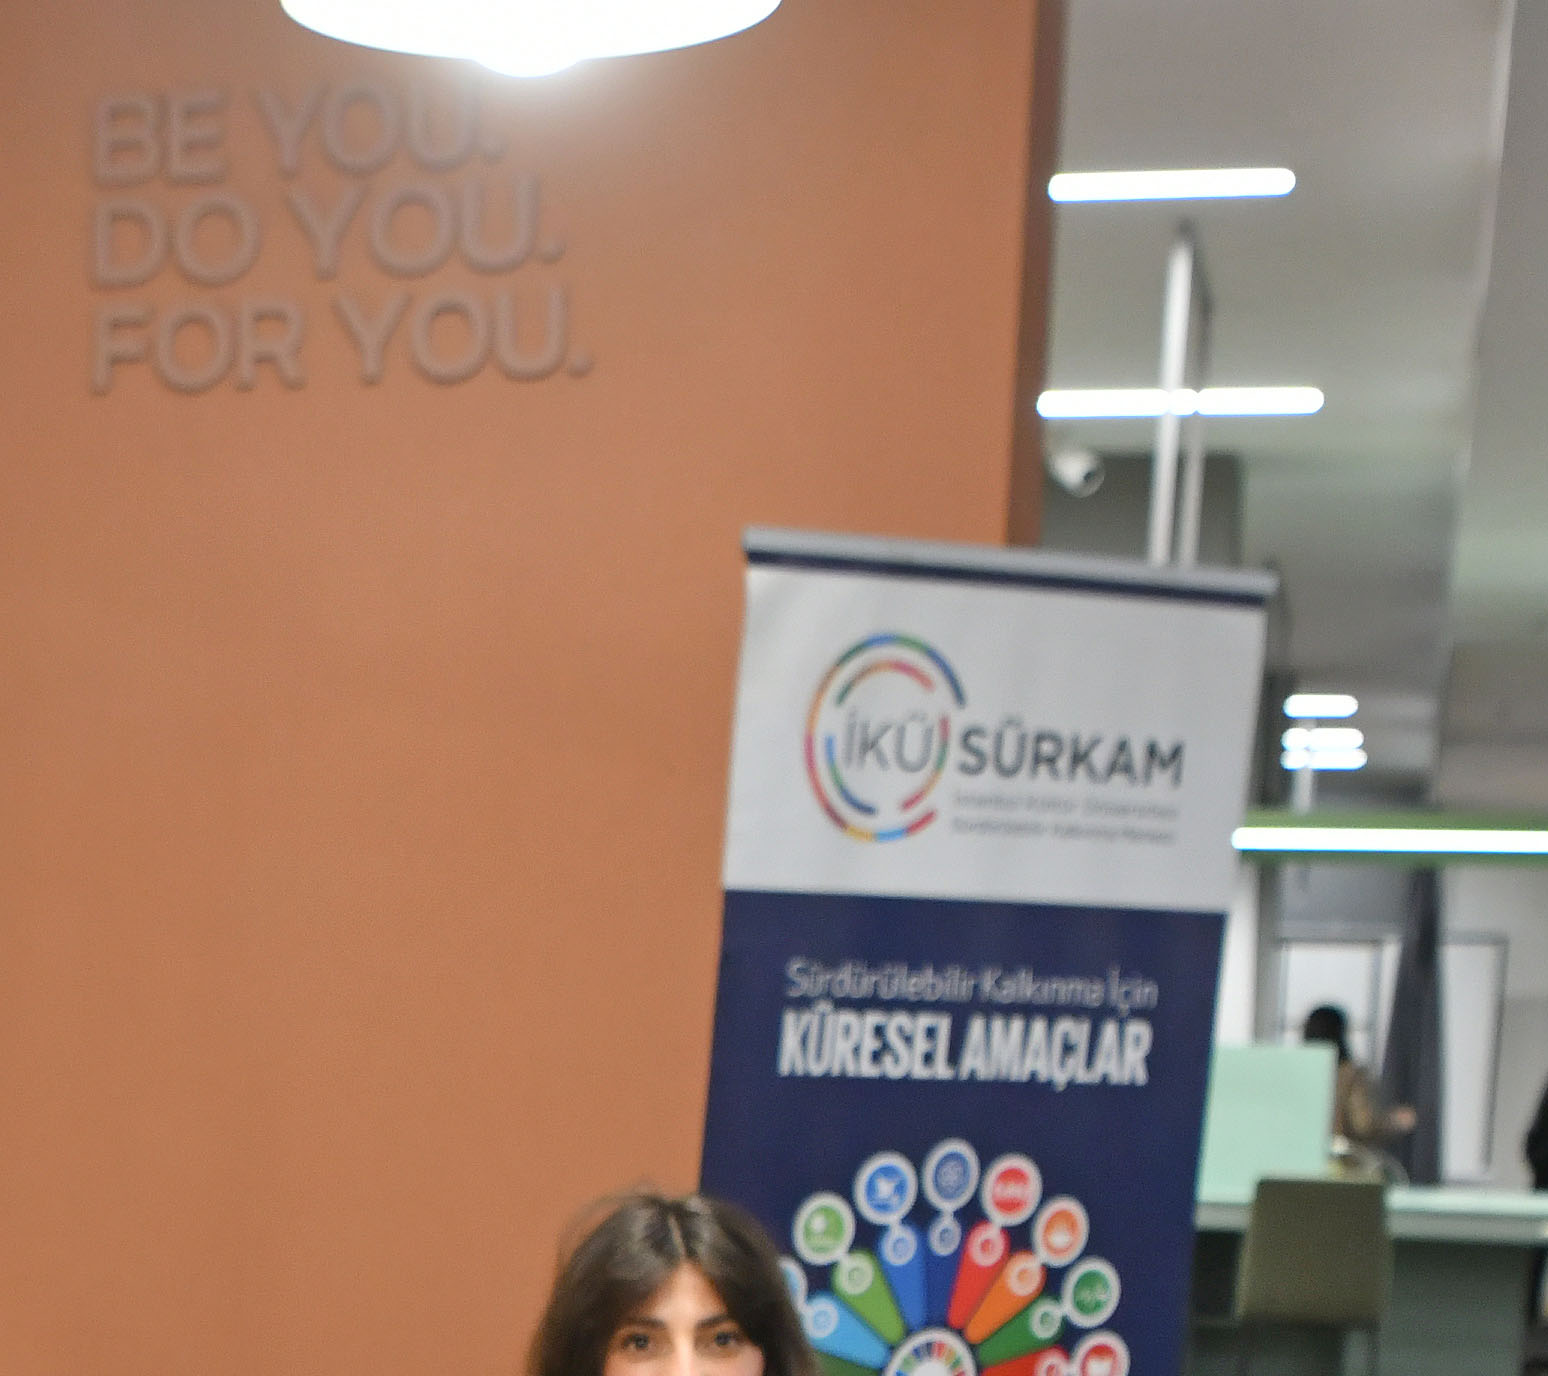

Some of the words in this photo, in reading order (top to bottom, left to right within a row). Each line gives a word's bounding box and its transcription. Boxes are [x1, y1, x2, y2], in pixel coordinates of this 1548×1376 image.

[93, 82, 230, 188] BE
[91, 196, 261, 292] DO
[290, 172, 566, 281] YOU.
[91, 300, 305, 396] FOR
[333, 280, 595, 386] YOU.
[843, 704, 935, 774] İKÜ
[957, 714, 1186, 789] SÜRKAM
[786, 955, 975, 1004] Sürdürülebilir
[980, 963, 1102, 1008] Kalkınma
[1106, 961, 1159, 1017] İçin
[777, 1001, 955, 1080] KÜRESEL
[959, 1012, 1154, 1091] AMAÇLAR
